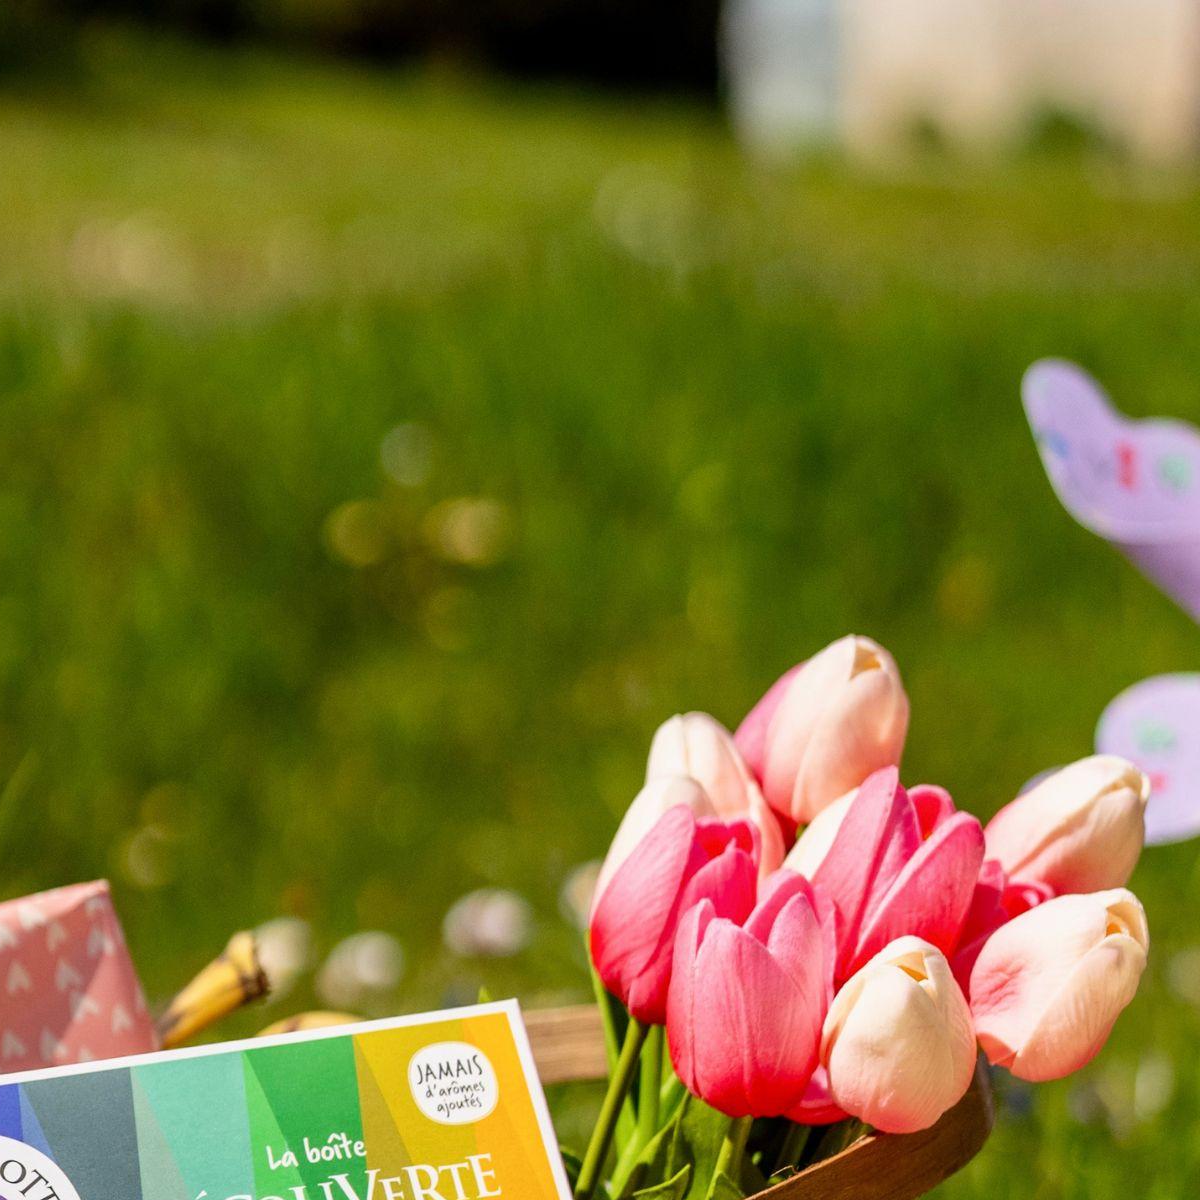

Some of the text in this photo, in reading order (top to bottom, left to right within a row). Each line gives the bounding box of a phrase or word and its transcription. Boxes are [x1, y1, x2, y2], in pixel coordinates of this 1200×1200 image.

[416, 1054, 484, 1085] JAMAIS
[425, 1081, 485, 1098] d'arômes
[437, 1093, 482, 1118] ajoutés
[266, 1132, 368, 1170] La boîte
